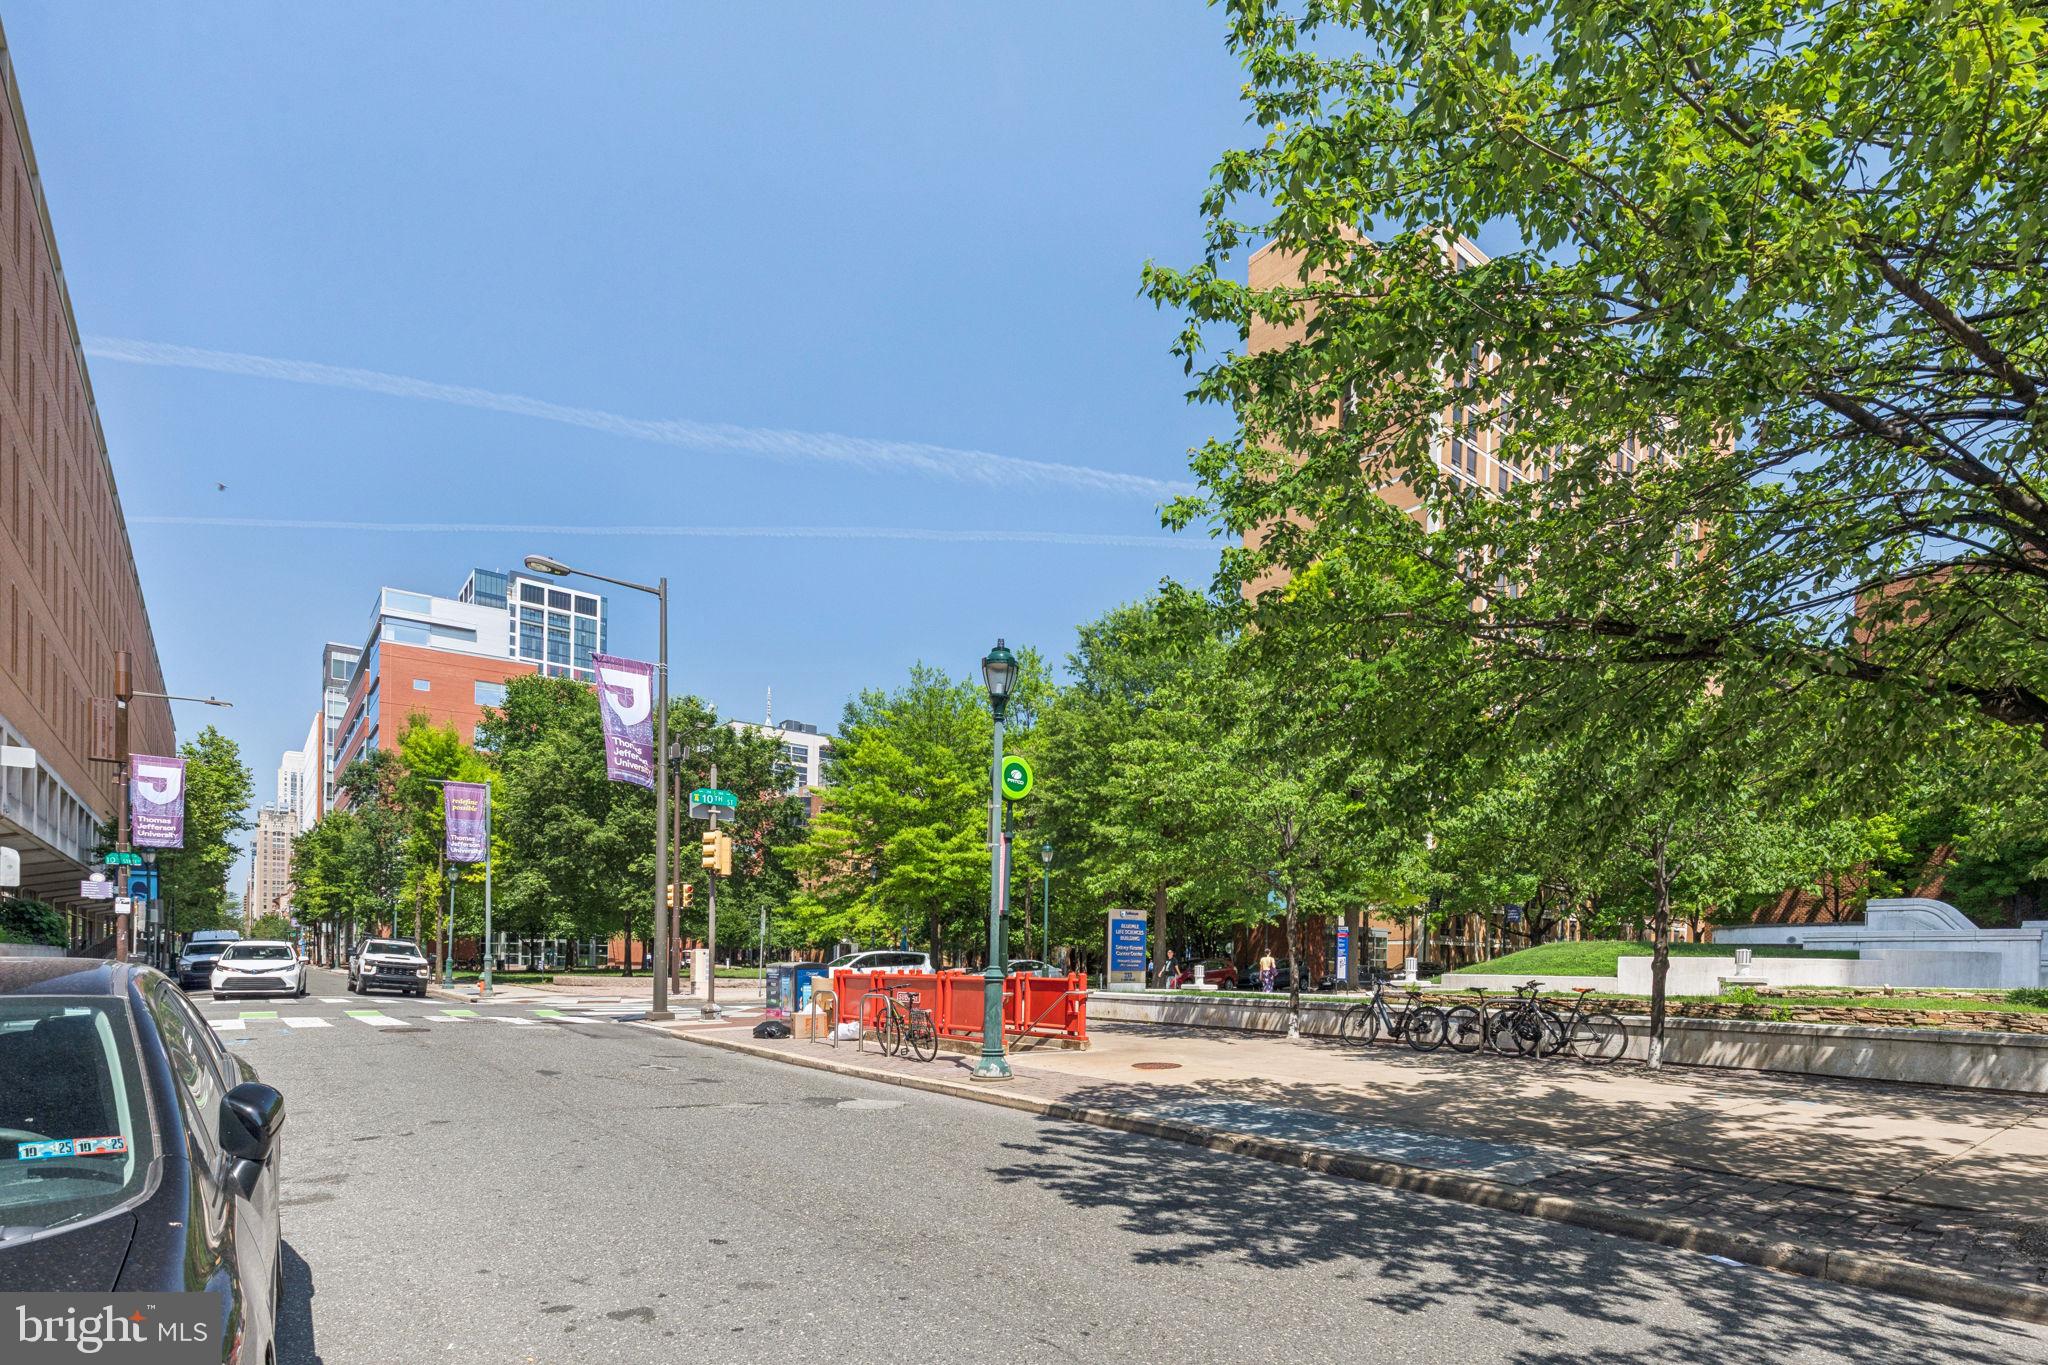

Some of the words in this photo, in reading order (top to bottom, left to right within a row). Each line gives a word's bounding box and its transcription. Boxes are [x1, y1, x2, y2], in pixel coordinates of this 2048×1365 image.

[611, 736, 642, 755] Thoms
[702, 794, 723, 804] 10TH
[137, 815, 171, 824] Thomas
[137, 823, 176, 831] Jefferson
[137, 830, 178, 838] University
[59, 1141, 72, 1154] 25
[111, 1138, 124, 1149] 25
